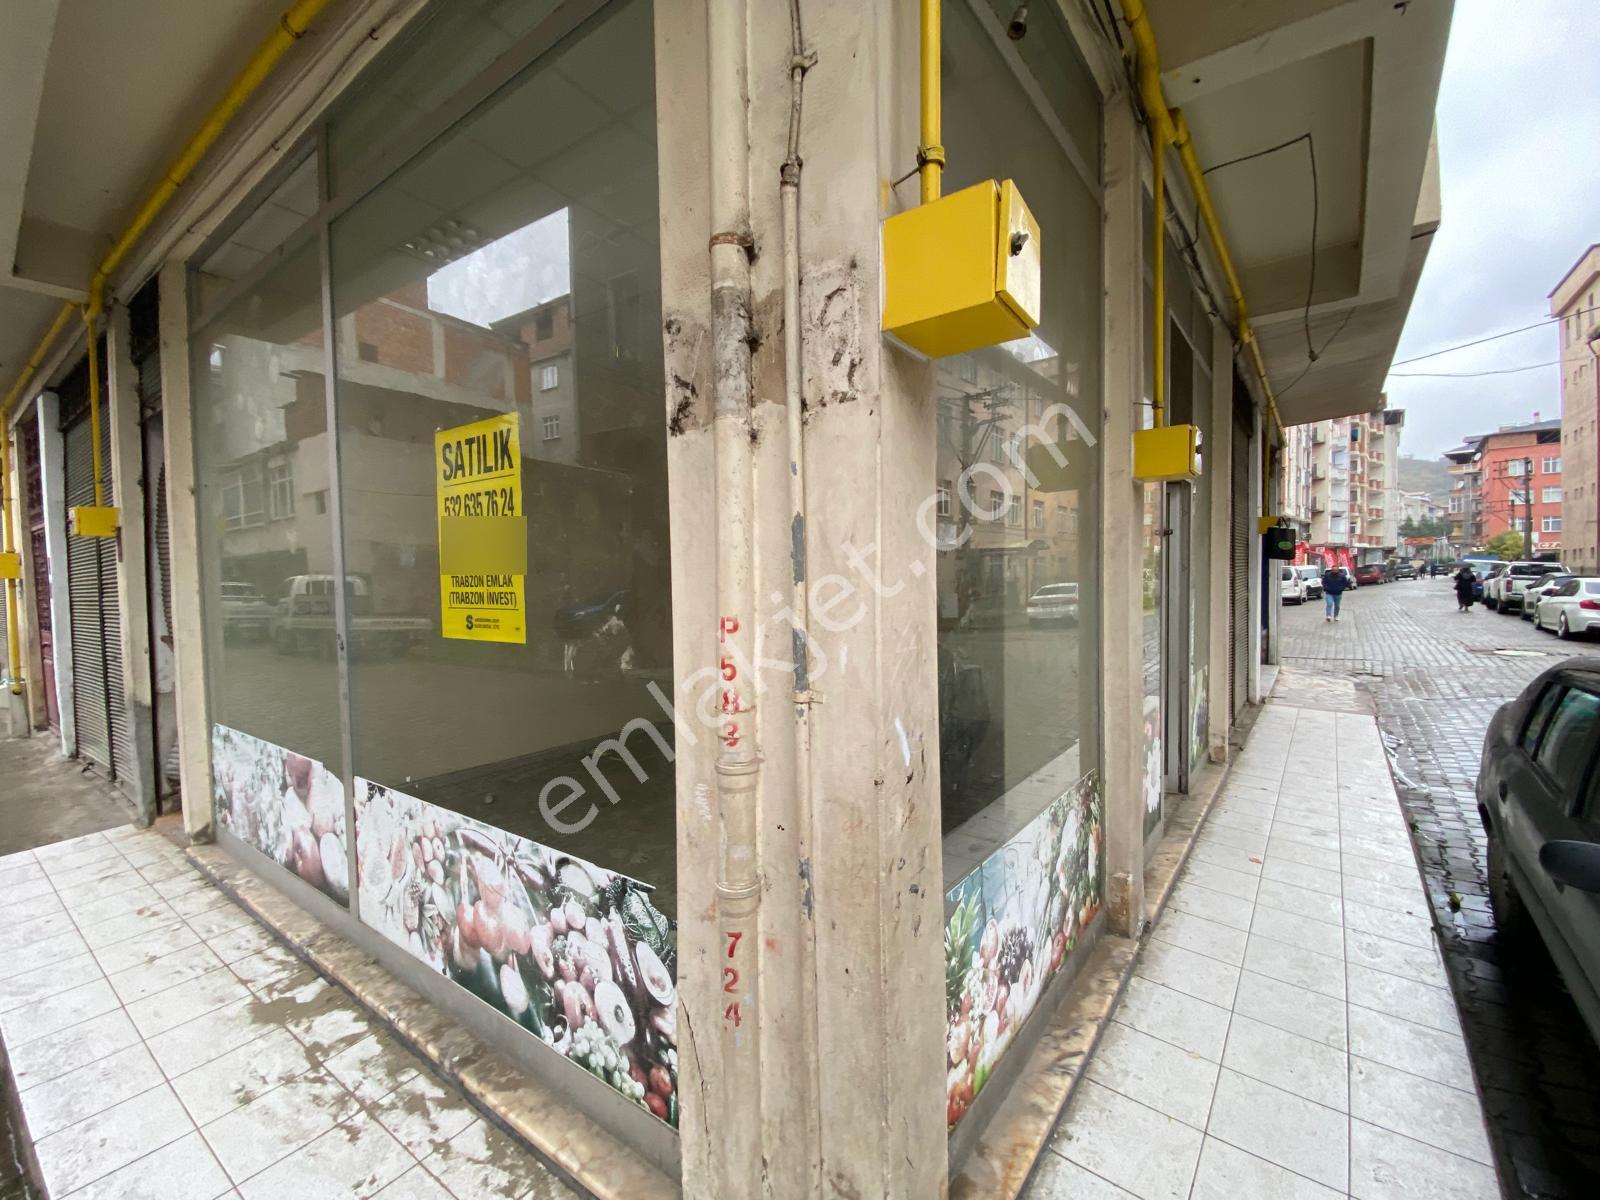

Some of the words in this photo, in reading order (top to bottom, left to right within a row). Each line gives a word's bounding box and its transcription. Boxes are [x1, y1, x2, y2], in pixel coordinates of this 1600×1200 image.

[442, 428, 514, 481] SATILIK
[444, 495, 462, 517] 532
[464, 493, 483, 517] 635
[484, 489, 498, 517] 76
[500, 486, 515, 517] 24
[451, 575, 485, 588] TRABZON
[486, 574, 514, 588] EMLAK
[448, 591, 485, 606] (TRABZON
